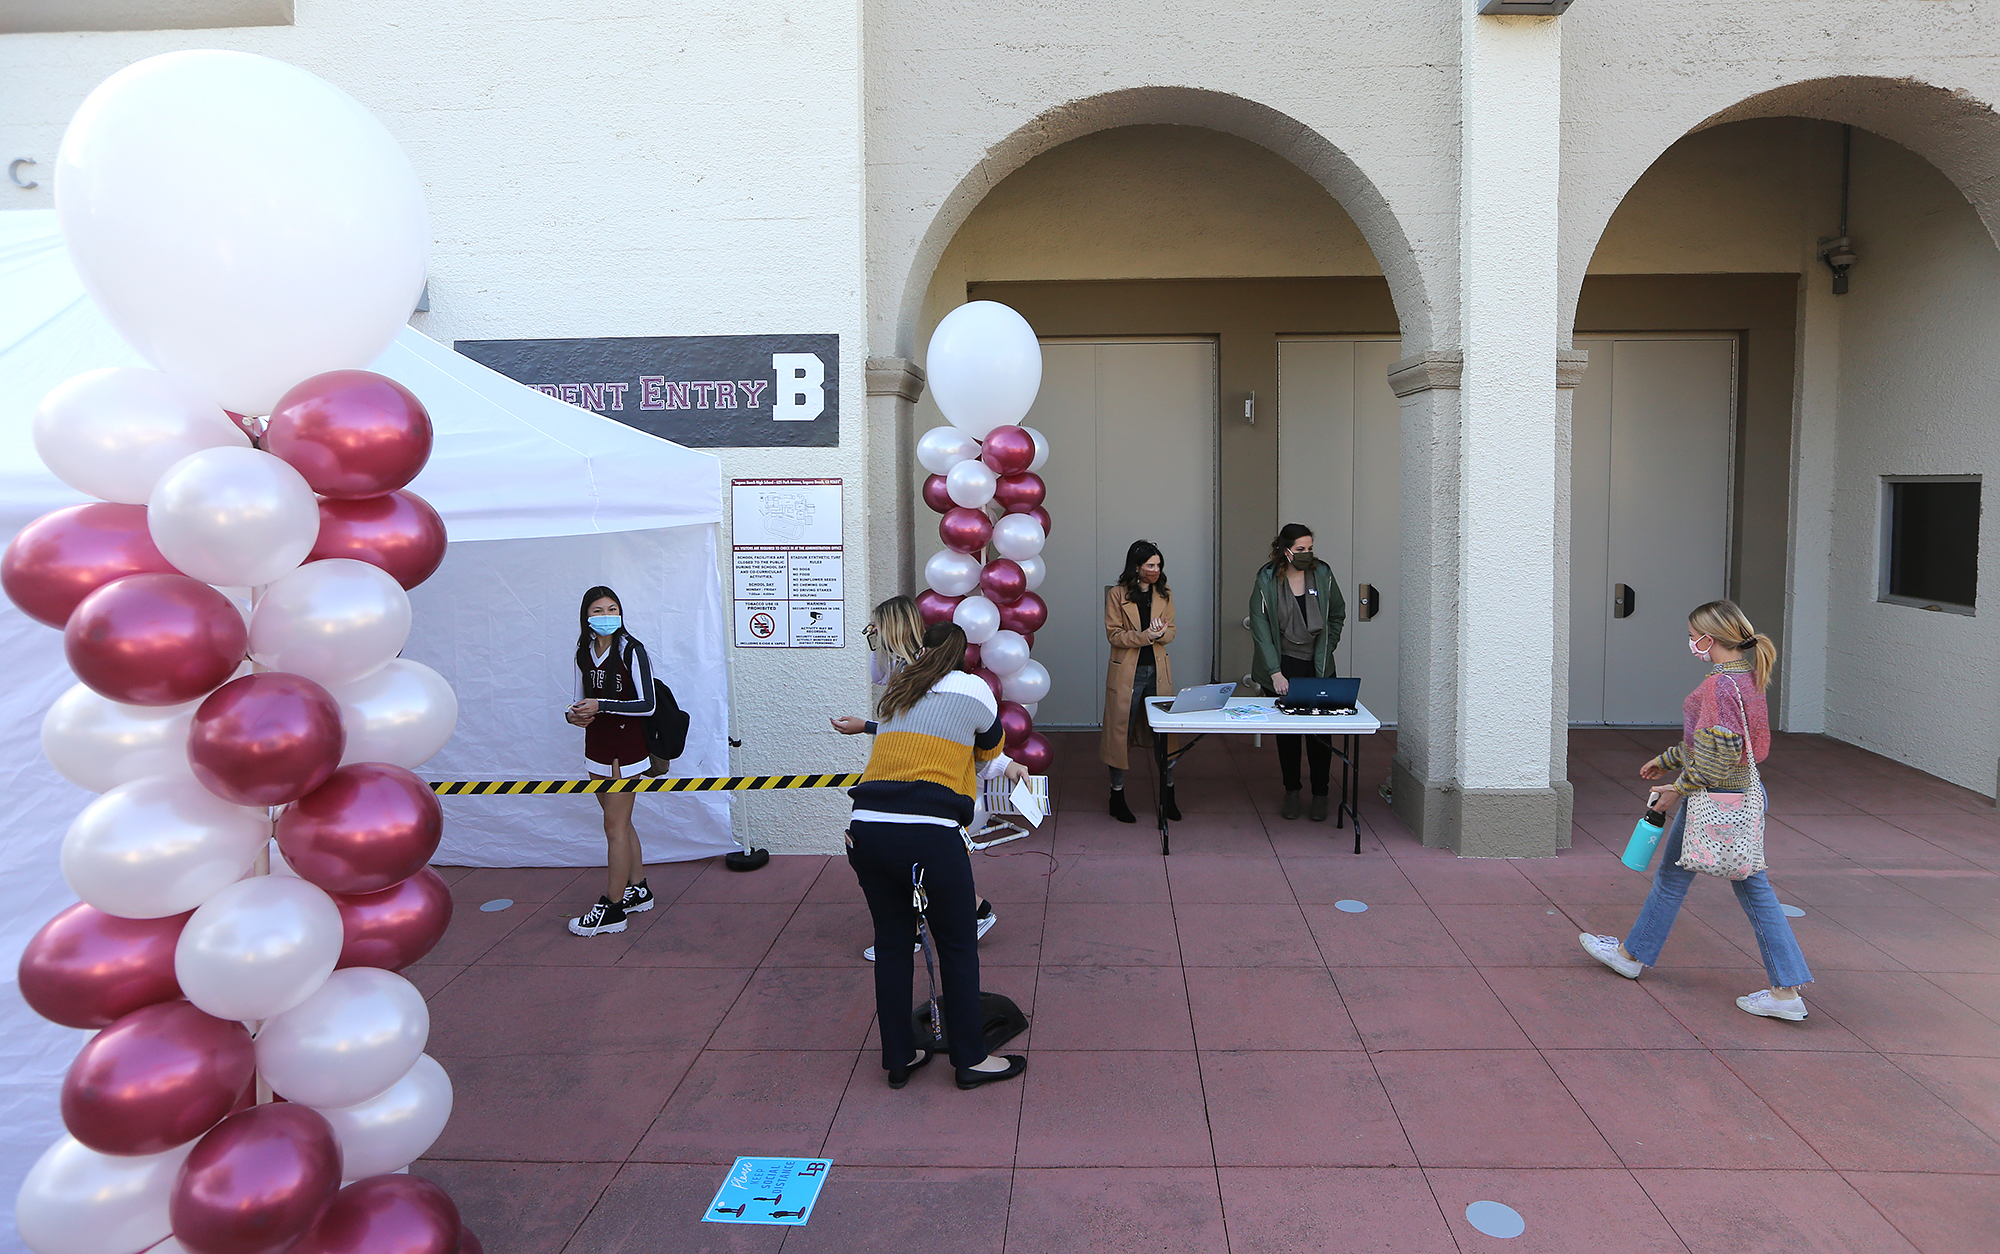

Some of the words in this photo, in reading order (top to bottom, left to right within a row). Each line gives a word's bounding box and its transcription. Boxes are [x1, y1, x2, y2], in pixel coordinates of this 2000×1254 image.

[8, 157, 38, 190] C
[639, 375, 768, 411] ENTRY
[772, 352, 825, 421] B
[731, 1162, 752, 1190] Please
[750, 1168, 765, 1185] KEEP
[761, 1165, 780, 1189] SOCIAL
[772, 1161, 796, 1194] DISTANCE
